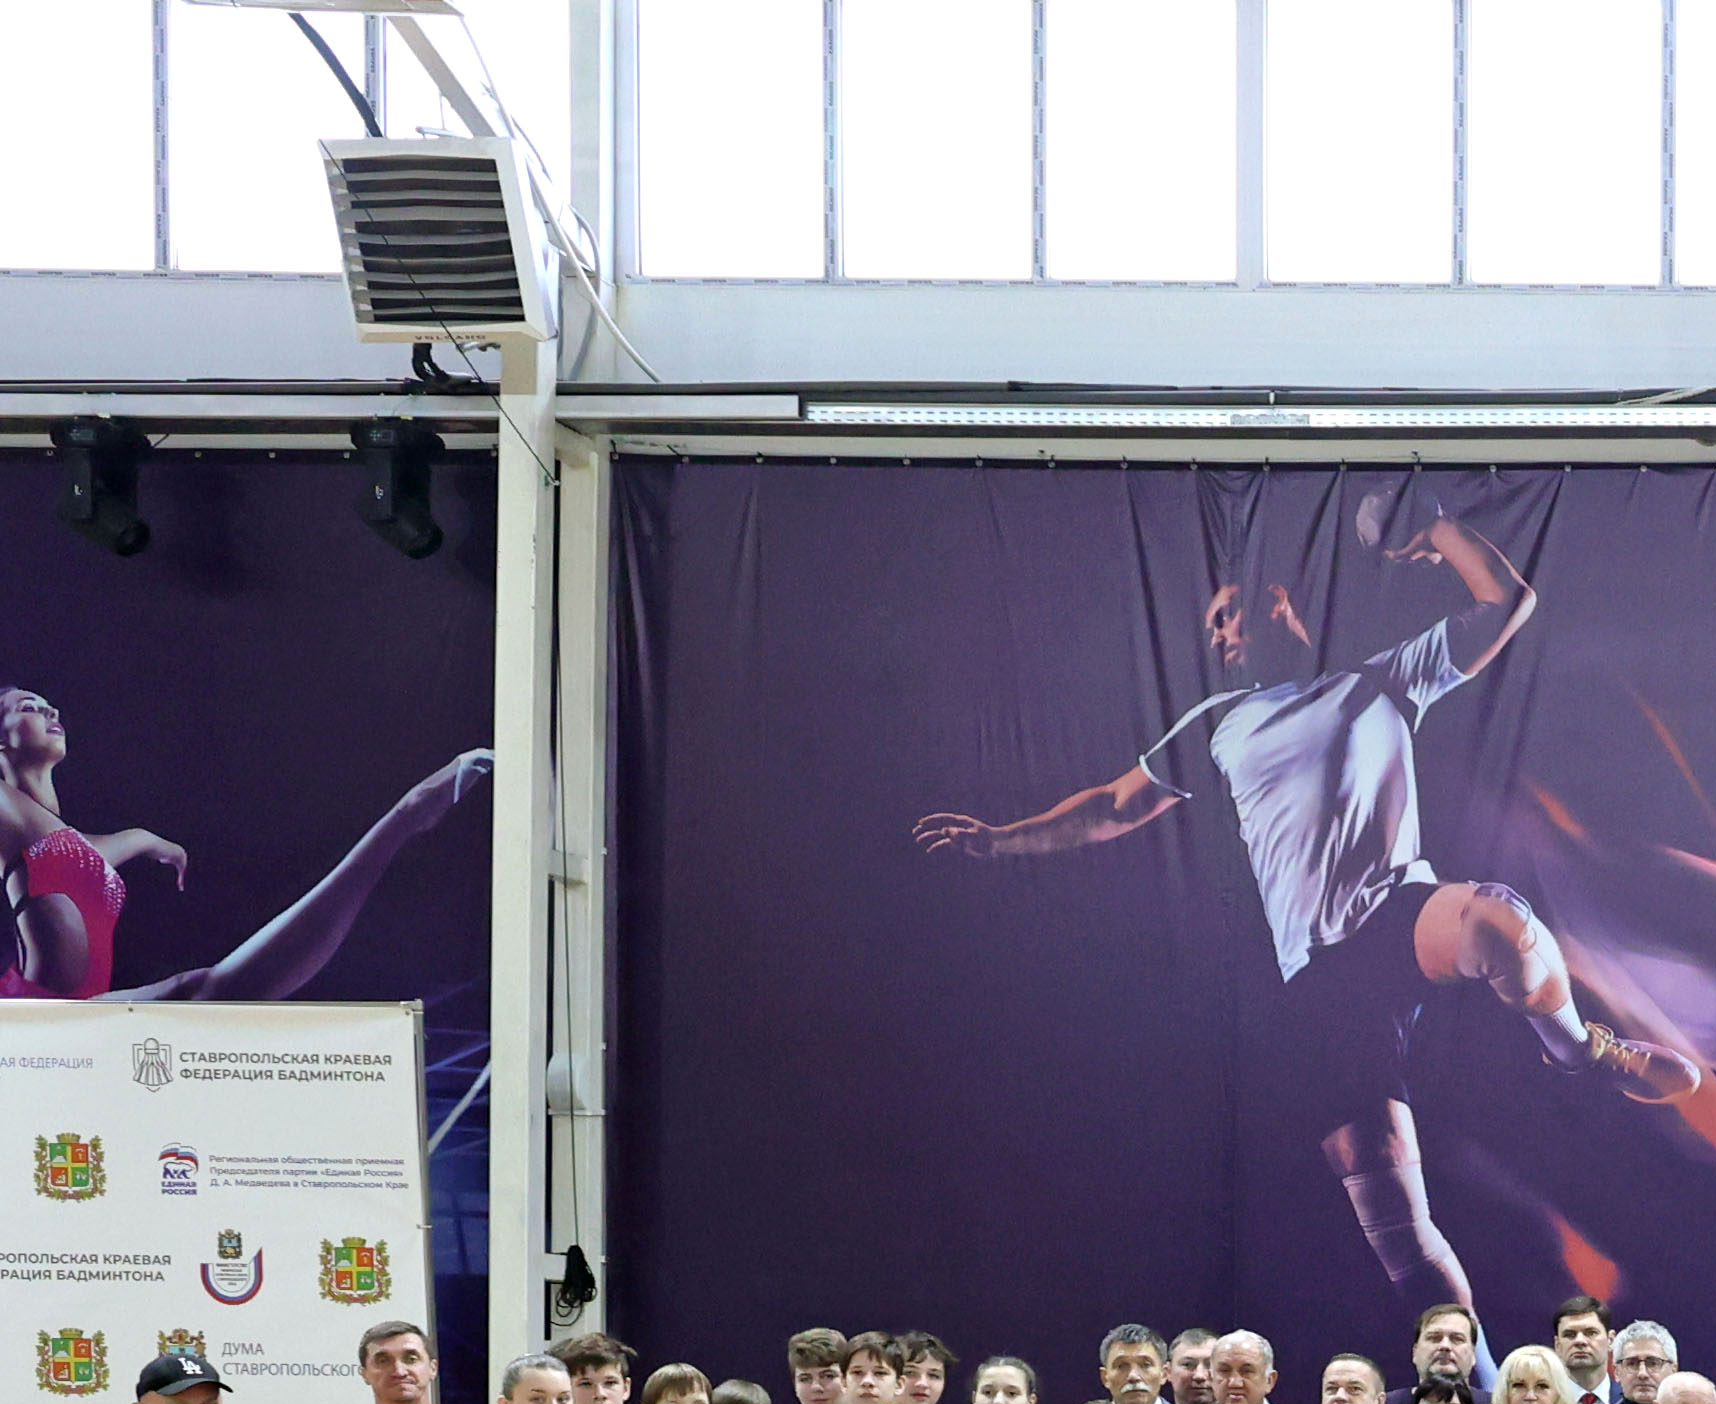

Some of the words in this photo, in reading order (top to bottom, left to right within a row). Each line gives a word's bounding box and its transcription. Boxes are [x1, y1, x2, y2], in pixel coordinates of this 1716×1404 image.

[179, 1051, 320, 1066] СТАВРОПОЛЬСКАЯ
[324, 1053, 392, 1067] КРАЕВАЯ
[179, 1068, 275, 1083] ФЕДЕРАЦИЯ
[278, 1069, 386, 1083] БАДМИНТОНА
[161, 1188, 198, 1196] РОССИЯ
[103, 1253, 171, 1266] КРАЕВАЯ
[56, 1268, 165, 1282] БАДМИНТОНА
[221, 1342, 265, 1357] ДУМА
[178, 1357, 203, 1374] LA
